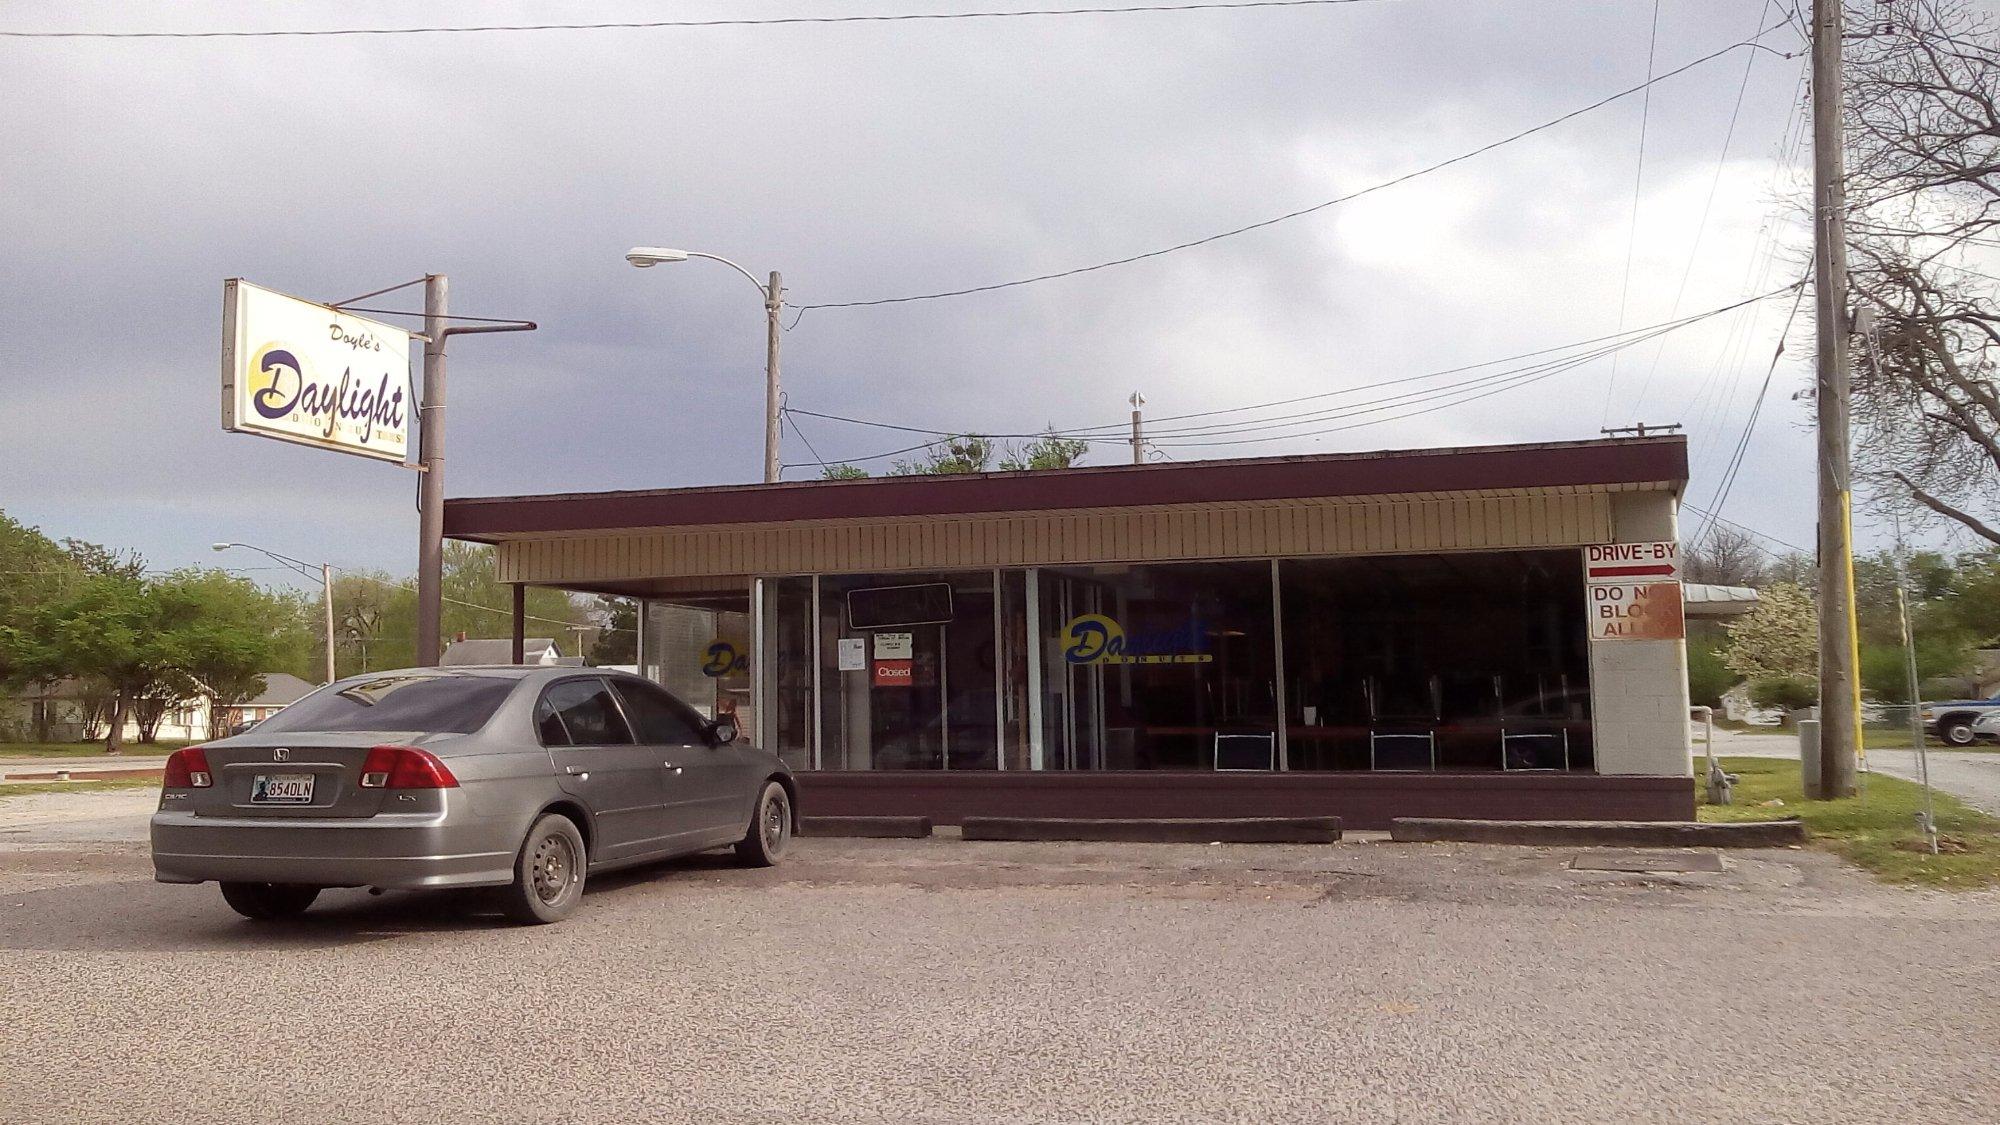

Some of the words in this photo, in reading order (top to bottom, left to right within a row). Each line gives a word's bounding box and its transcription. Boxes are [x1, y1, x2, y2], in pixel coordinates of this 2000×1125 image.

[253, 349, 403, 444] Daylight
[292, 413, 402, 443] DONUTS
[1589, 543, 1676, 562] DRIVE-BY
[1594, 586, 1624, 601] DO
[1600, 604, 1656, 619] BLO
[878, 667, 911, 677] Closed
[269, 782, 312, 797] 854DLN
